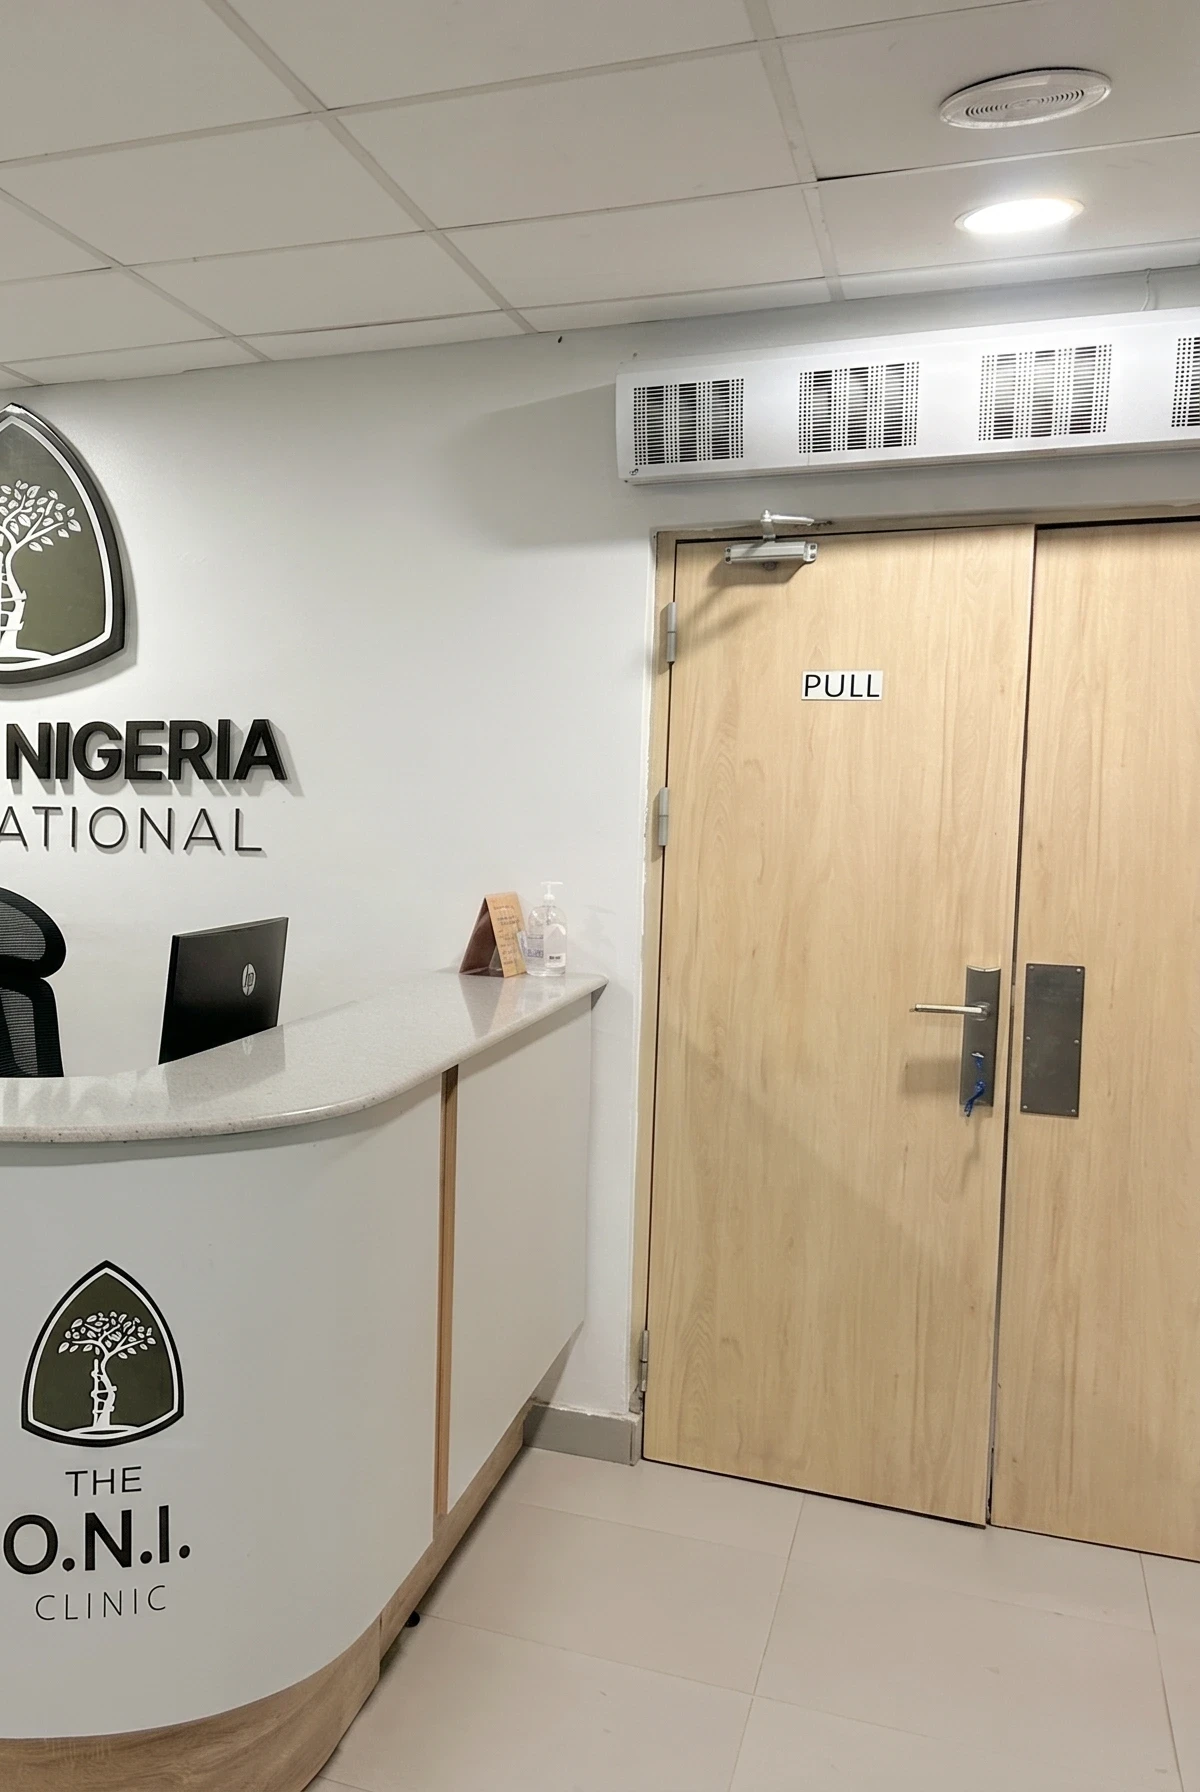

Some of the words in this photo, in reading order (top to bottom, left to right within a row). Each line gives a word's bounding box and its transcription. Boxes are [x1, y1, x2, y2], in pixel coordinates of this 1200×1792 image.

[804, 673, 881, 698] PULL
[5, 718, 288, 781] NIGERIA
[65, 1465, 142, 1497] THE
[2, 1504, 191, 1575] O.N.I.
[35, 1584, 166, 1621] CLINIC
